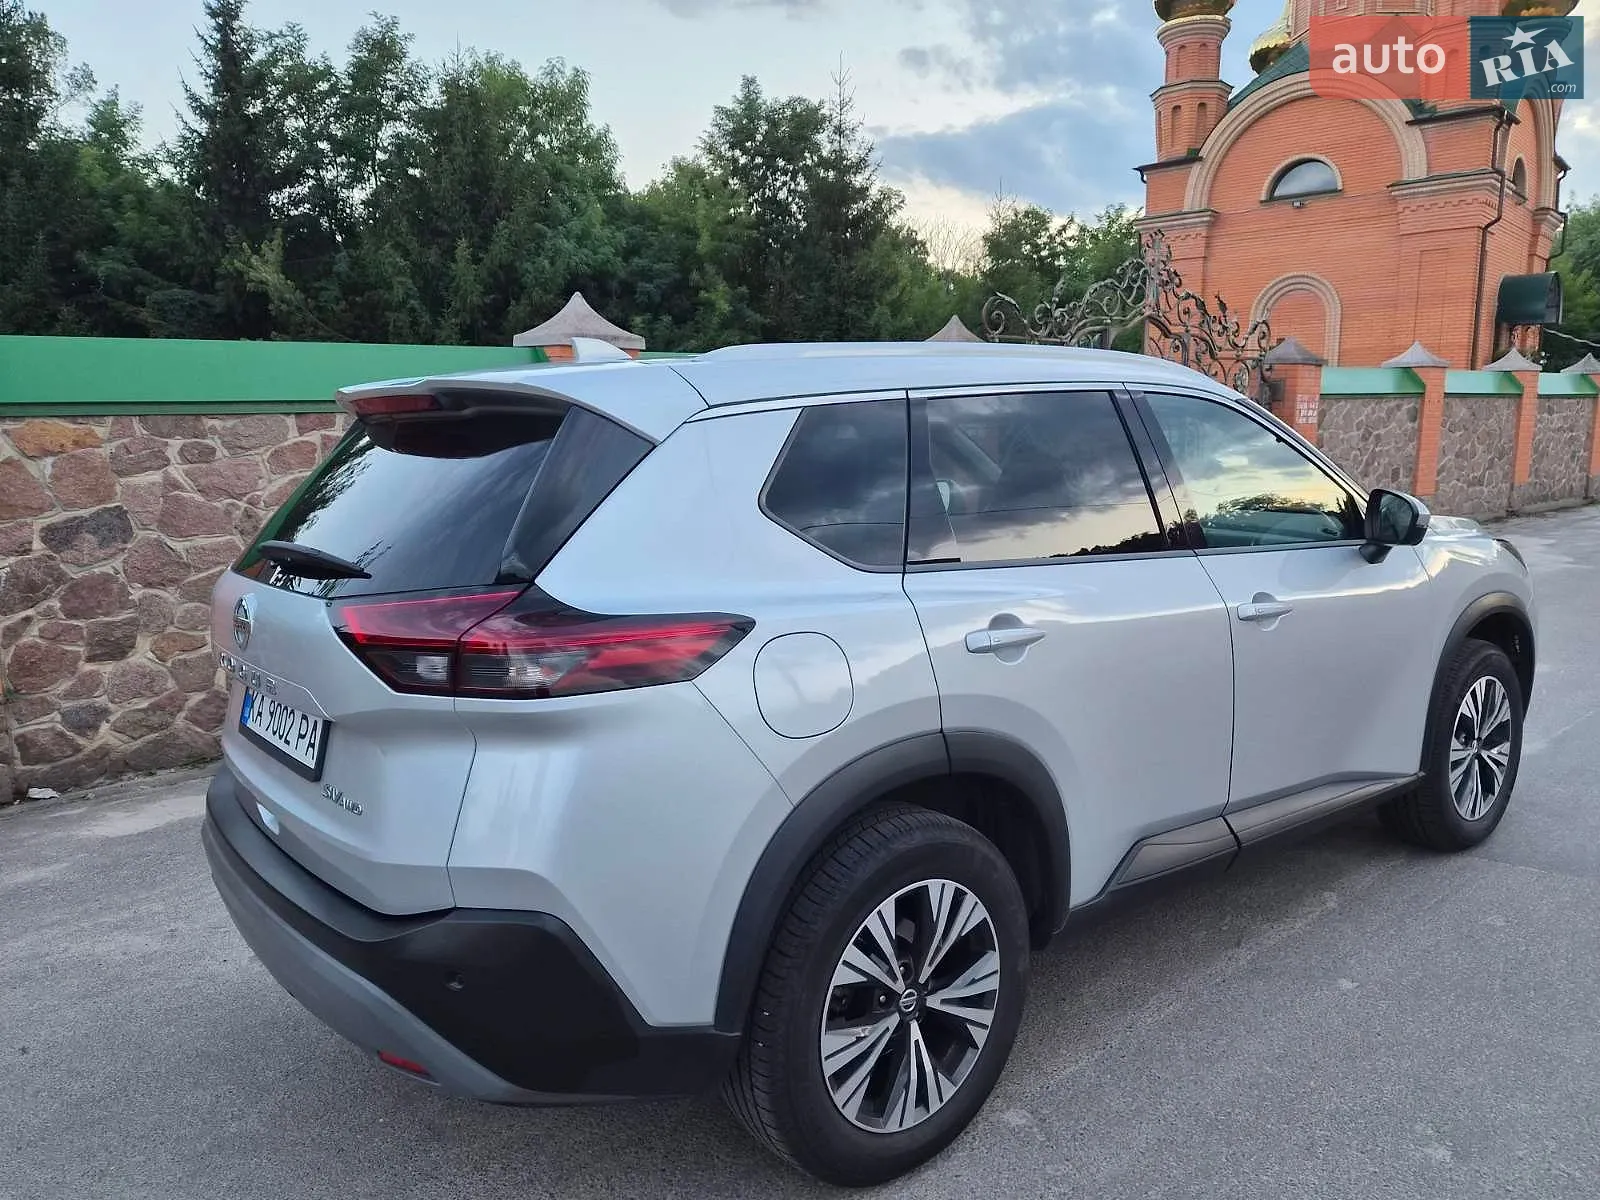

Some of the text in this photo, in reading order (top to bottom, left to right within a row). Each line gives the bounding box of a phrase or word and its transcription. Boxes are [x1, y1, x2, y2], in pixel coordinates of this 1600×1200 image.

[248, 690, 318, 760] KA 9002 PA
